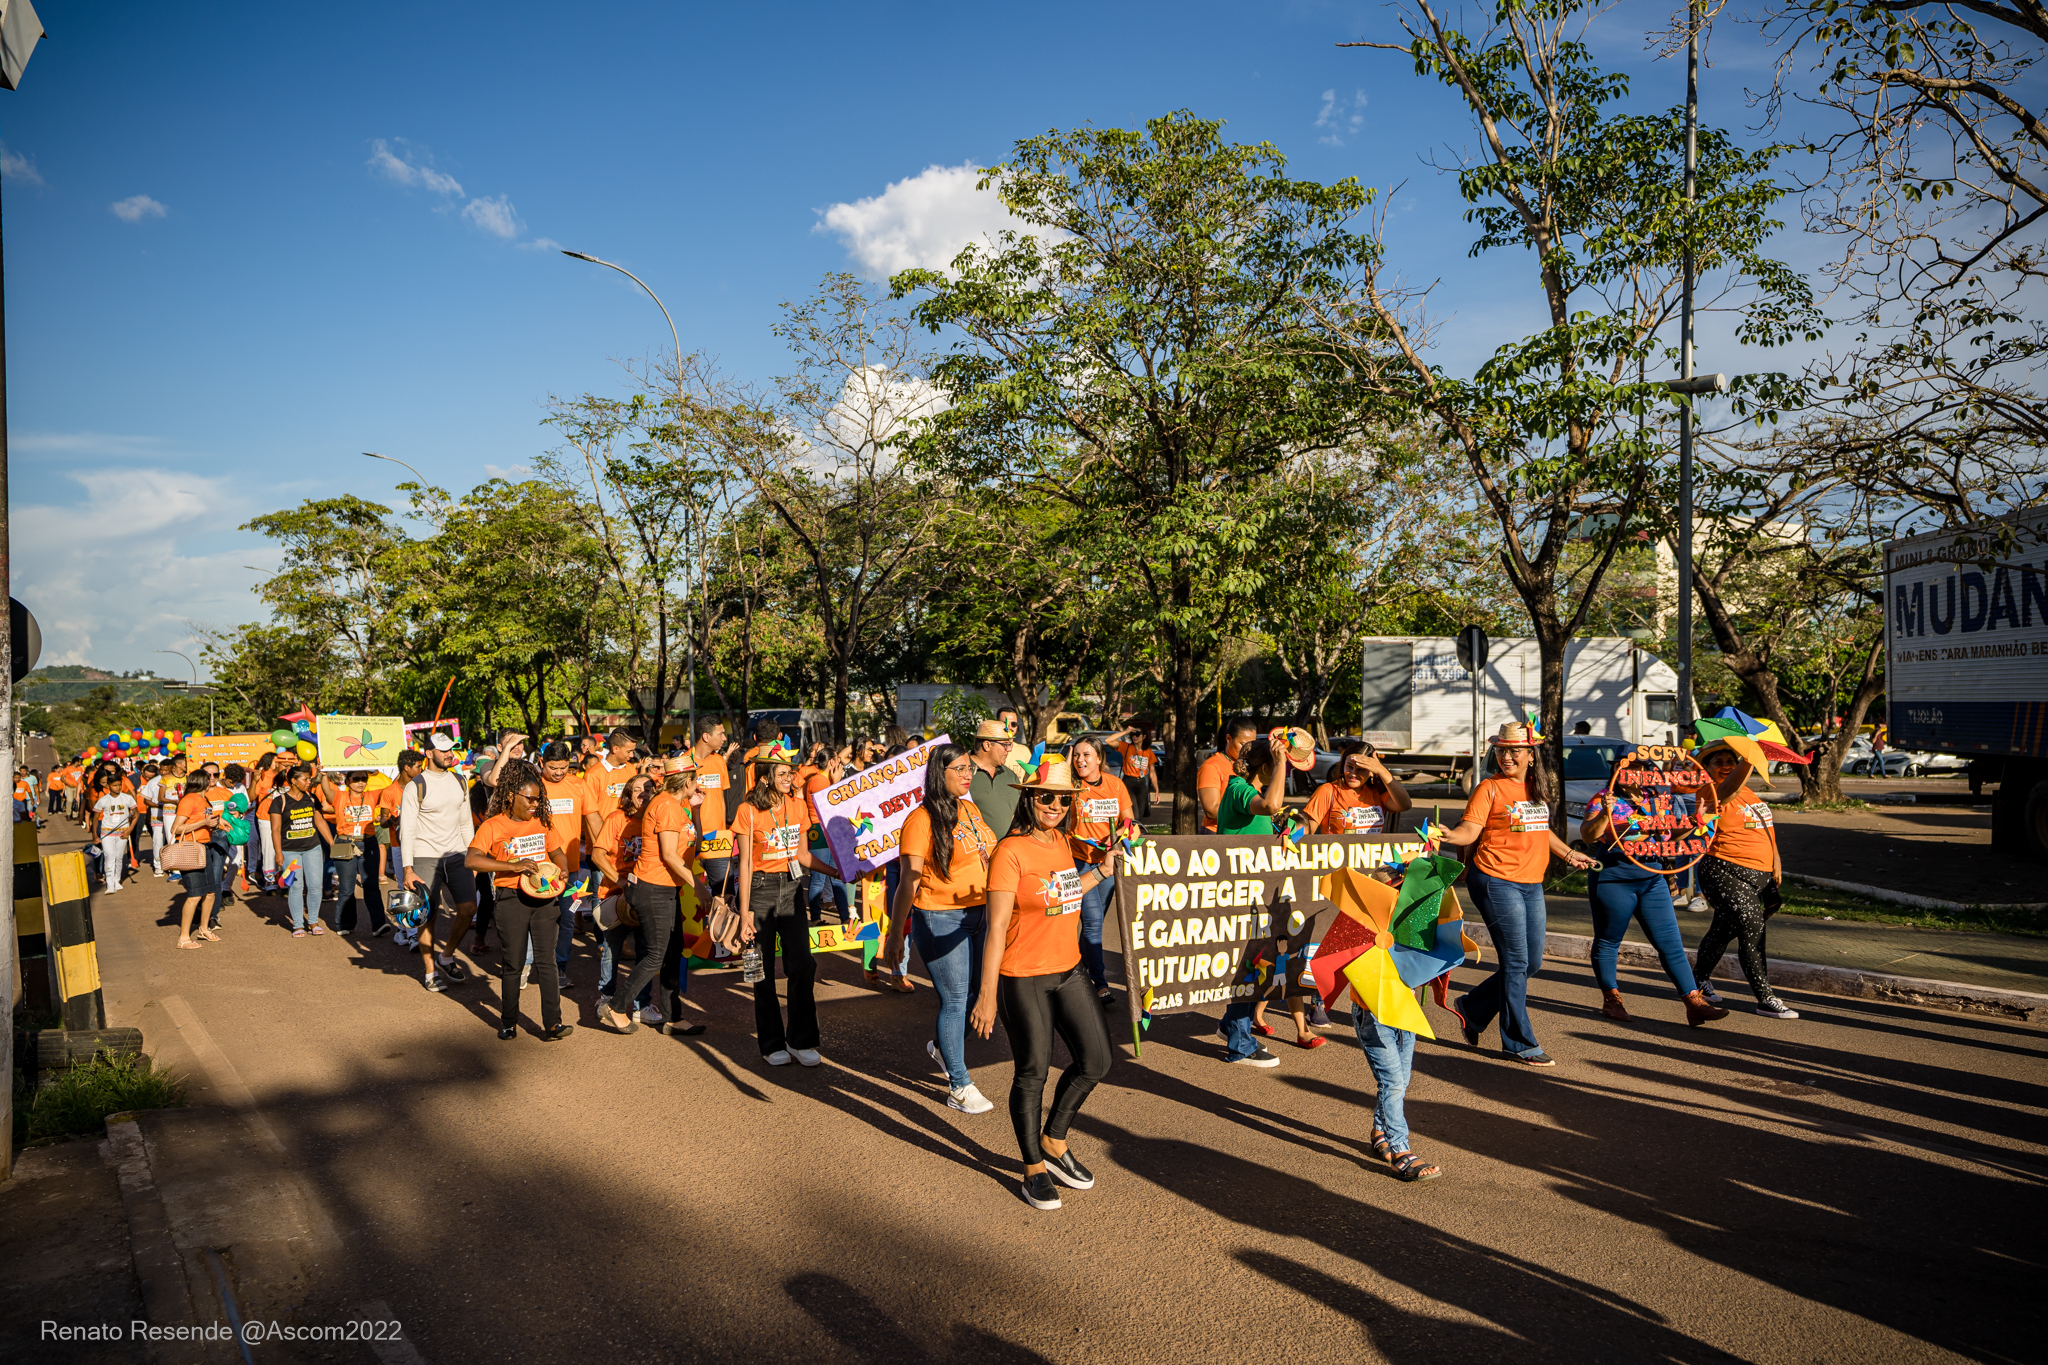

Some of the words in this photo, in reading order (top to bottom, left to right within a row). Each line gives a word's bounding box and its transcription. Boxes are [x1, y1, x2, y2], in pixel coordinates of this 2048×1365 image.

[1897, 649, 1938, 663] VIAGENS
[1942, 647, 1969, 660] PARA
[1971, 640, 2027, 659] MARANHÃO
[1637, 745, 1688, 762] SCFV
[827, 759, 908, 805] CRIANÇA
[1618, 767, 1714, 787] INFÂNCIA
[879, 786, 925, 818] DEVE
[1659, 790, 1673, 811] É
[1642, 814, 1694, 831] PARA
[1623, 836, 1710, 857] SONHAR!
[1122, 840, 1181, 877] NÃO
[1187, 848, 1221, 877] AO
[1225, 842, 1345, 875] TRABALHO
[1136, 879, 1265, 912] PROTEGER
[1279, 876, 1297, 903] A
[1131, 911, 1145, 950] É
[1148, 913, 1272, 948] GARANTIR
[1287, 910, 1306, 937] O
[1138, 948, 1240, 988] FUTURO!
[1188, 982, 1255, 1005] MINÉRIOS
